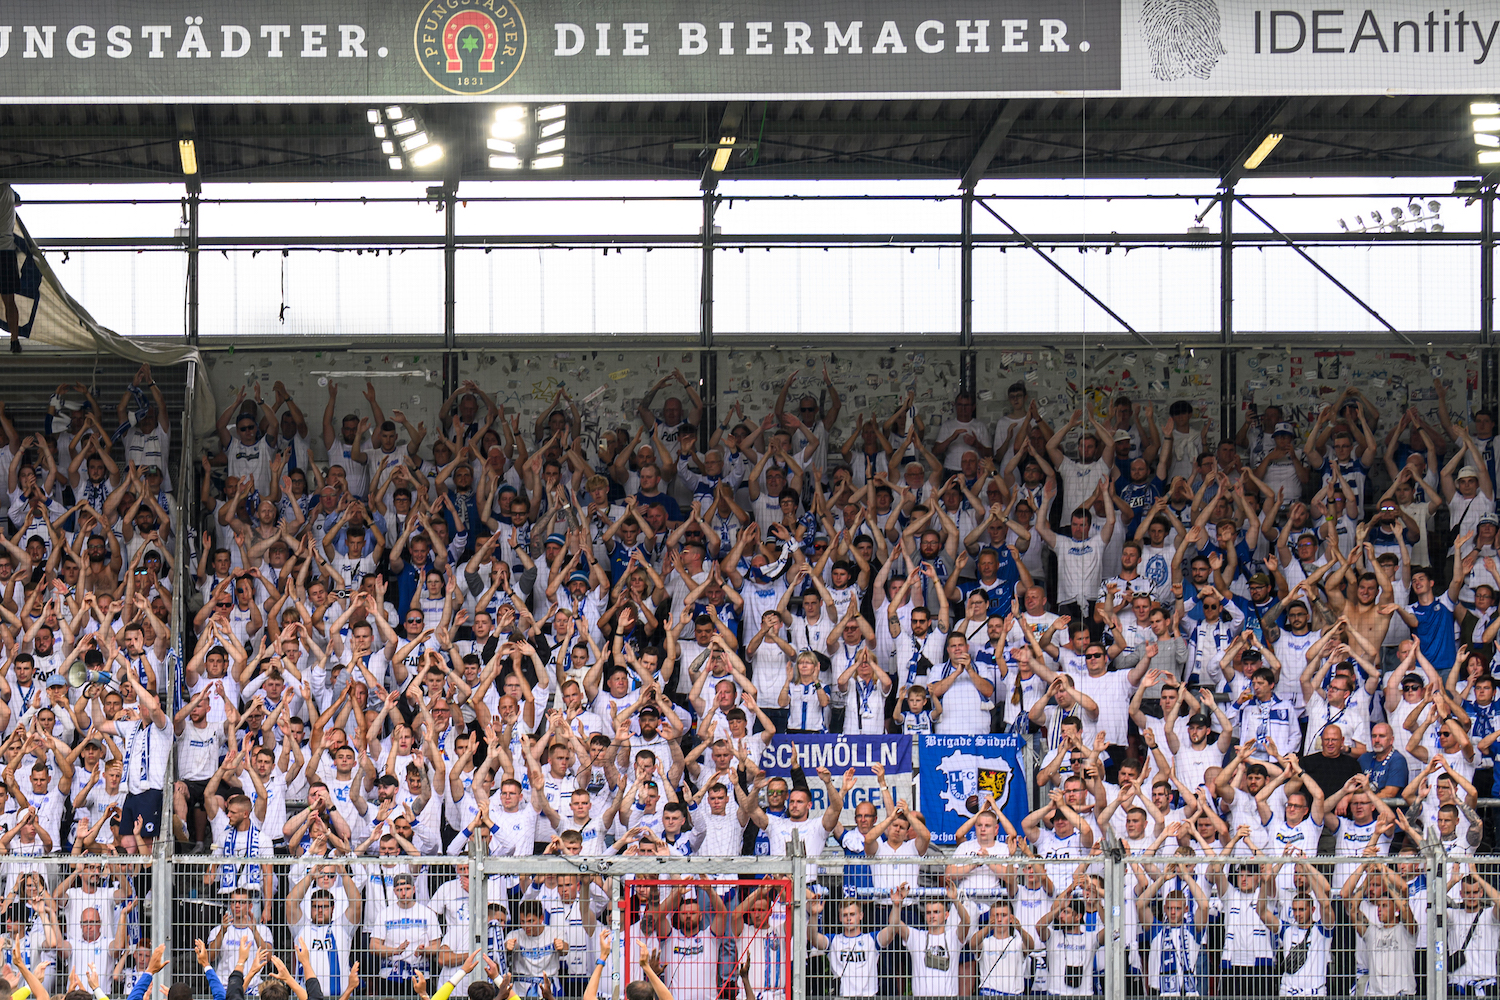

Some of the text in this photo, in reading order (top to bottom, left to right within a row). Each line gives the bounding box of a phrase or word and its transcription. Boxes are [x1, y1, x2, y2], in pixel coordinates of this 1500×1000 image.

[554, 19, 1092, 57] DIE BIERMACHER.
[1254, 8, 1499, 64] IDEAntity
[457, 77, 484, 86] 1831
[762, 736, 898, 769] SCHMÖLLN
[925, 734, 1017, 748] Brigade Südpfa
